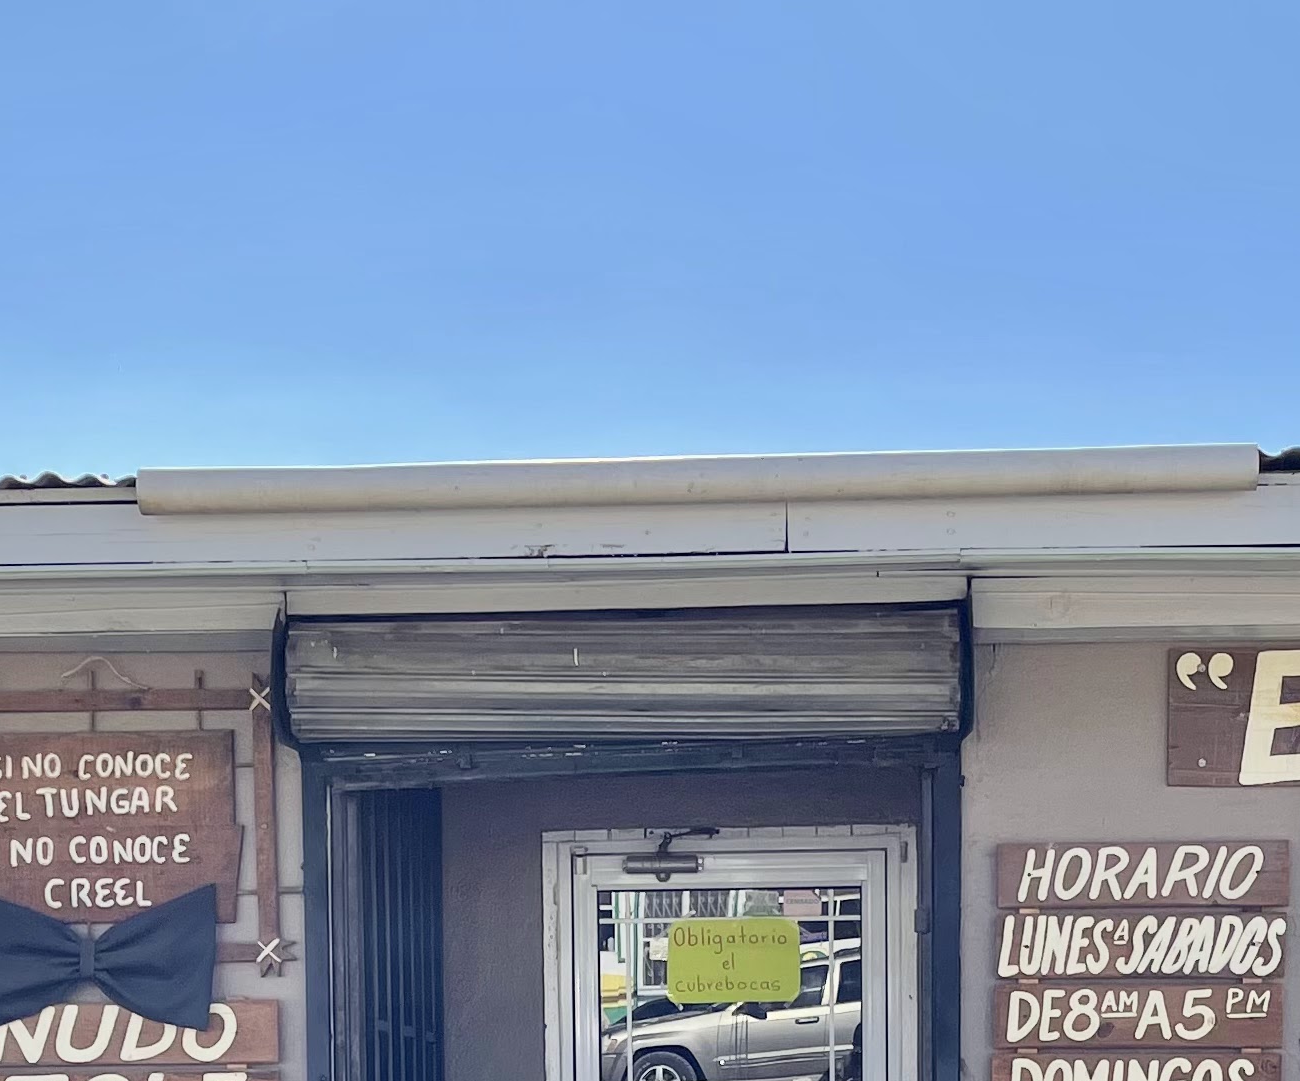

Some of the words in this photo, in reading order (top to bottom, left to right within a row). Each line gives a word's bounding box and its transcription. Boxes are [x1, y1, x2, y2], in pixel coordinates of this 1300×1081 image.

[78, 751, 193, 780] CONOCE
[37, 785, 178, 817] TUNGAR
[10, 836, 54, 867] NO
[69, 833, 191, 865] CONOCE
[1018, 846, 1264, 902] HORARIO
[44, 879, 152, 909] CREEL
[673, 926, 787, 954] Obligatorio
[998, 915, 1113, 978] LUNES
[1115, 915, 1286, 977] SABADOS
[722, 952, 735, 970] el
[675, 975, 781, 992] cubrebocas
